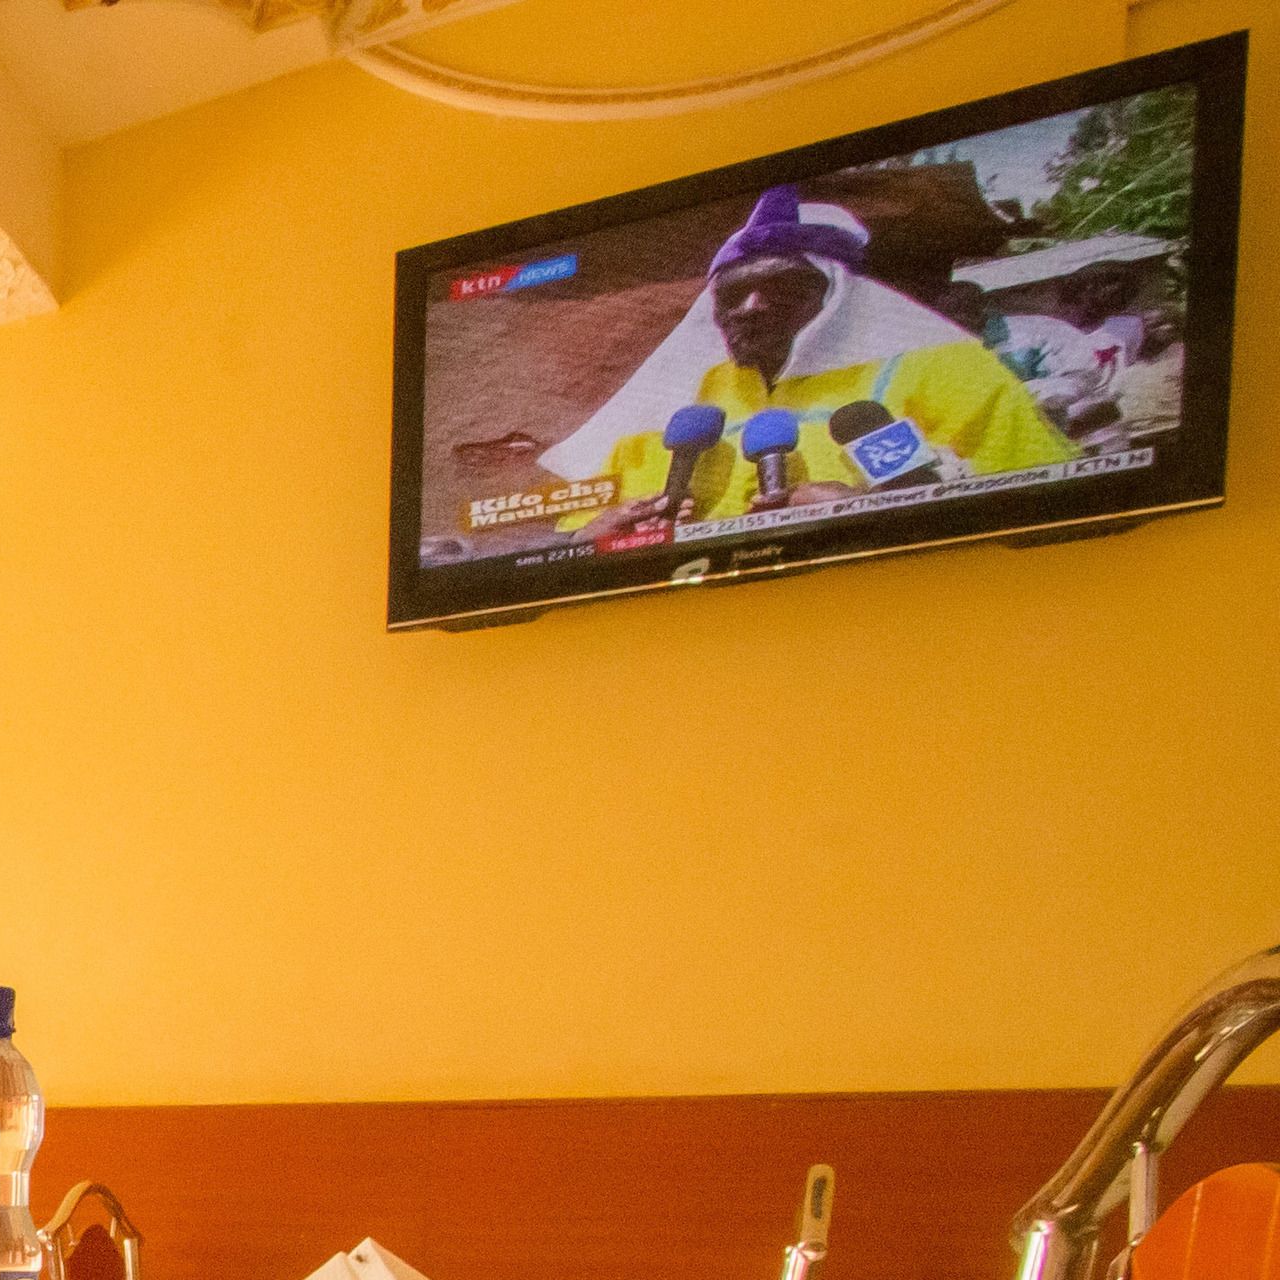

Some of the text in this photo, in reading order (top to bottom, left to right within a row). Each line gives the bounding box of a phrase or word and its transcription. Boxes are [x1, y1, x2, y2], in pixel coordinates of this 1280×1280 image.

[461, 263, 568, 294] ktn NEWS
[470, 481, 615, 515] Kifo cha
[681, 524, 713, 538] SMS
[718, 517, 765, 534] 22155
[1075, 457, 1121, 474] KTN
